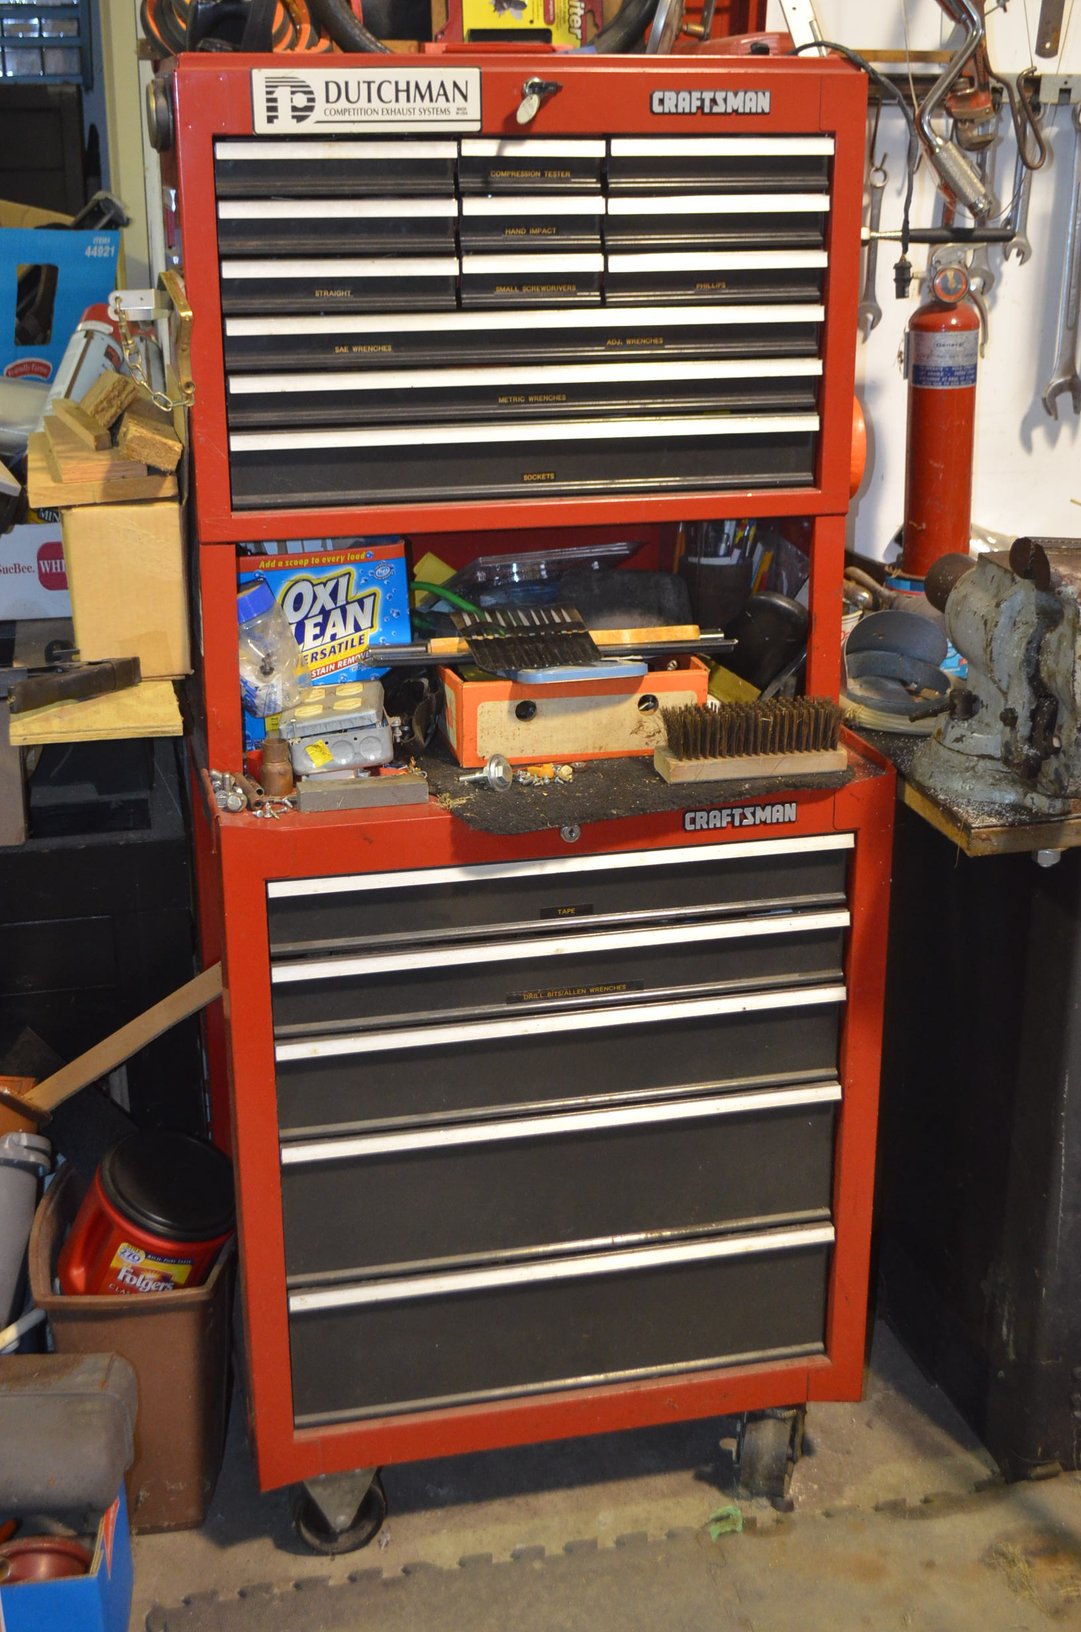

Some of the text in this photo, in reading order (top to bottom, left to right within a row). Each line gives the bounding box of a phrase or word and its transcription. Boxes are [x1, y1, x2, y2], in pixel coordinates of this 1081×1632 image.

[324, 80, 468, 104] DUTCHMAN
[651, 90, 770, 114] CRAFTSMAN
[323, 107, 379, 117] COMPETITION
[381, 107, 416, 116] EXHAUST
[418, 107, 451, 116] SYSTEMS
[490, 170, 571, 178] COMPRESSION TESTER
[529, 227, 556, 235] IMPACT
[495, 285, 518, 293] SMALL
[696, 281, 726, 289] PHILLIPS
[606, 337, 664, 346] ADJ. WRENCHES
[352, 344, 392, 352] WRENCHES
[498, 393, 567, 404] METRIC WRENCHES
[523, 472, 555, 481] SOCKETS
[259, 560, 276, 568] Add
[285, 559, 309, 567] scoop
[322, 555, 345, 563] every
[347, 552, 366, 560] load
[283, 574, 350, 624] OXI
[311, 663, 335, 678] STAIN
[684, 802, 797, 831] CRAFTSMAN
[557, 907, 576, 915] TAPE
[523, 984, 627, 1000] DRILL BITS/ALLEN WRENCHES
[117, 1265, 175, 1292] Folgers
